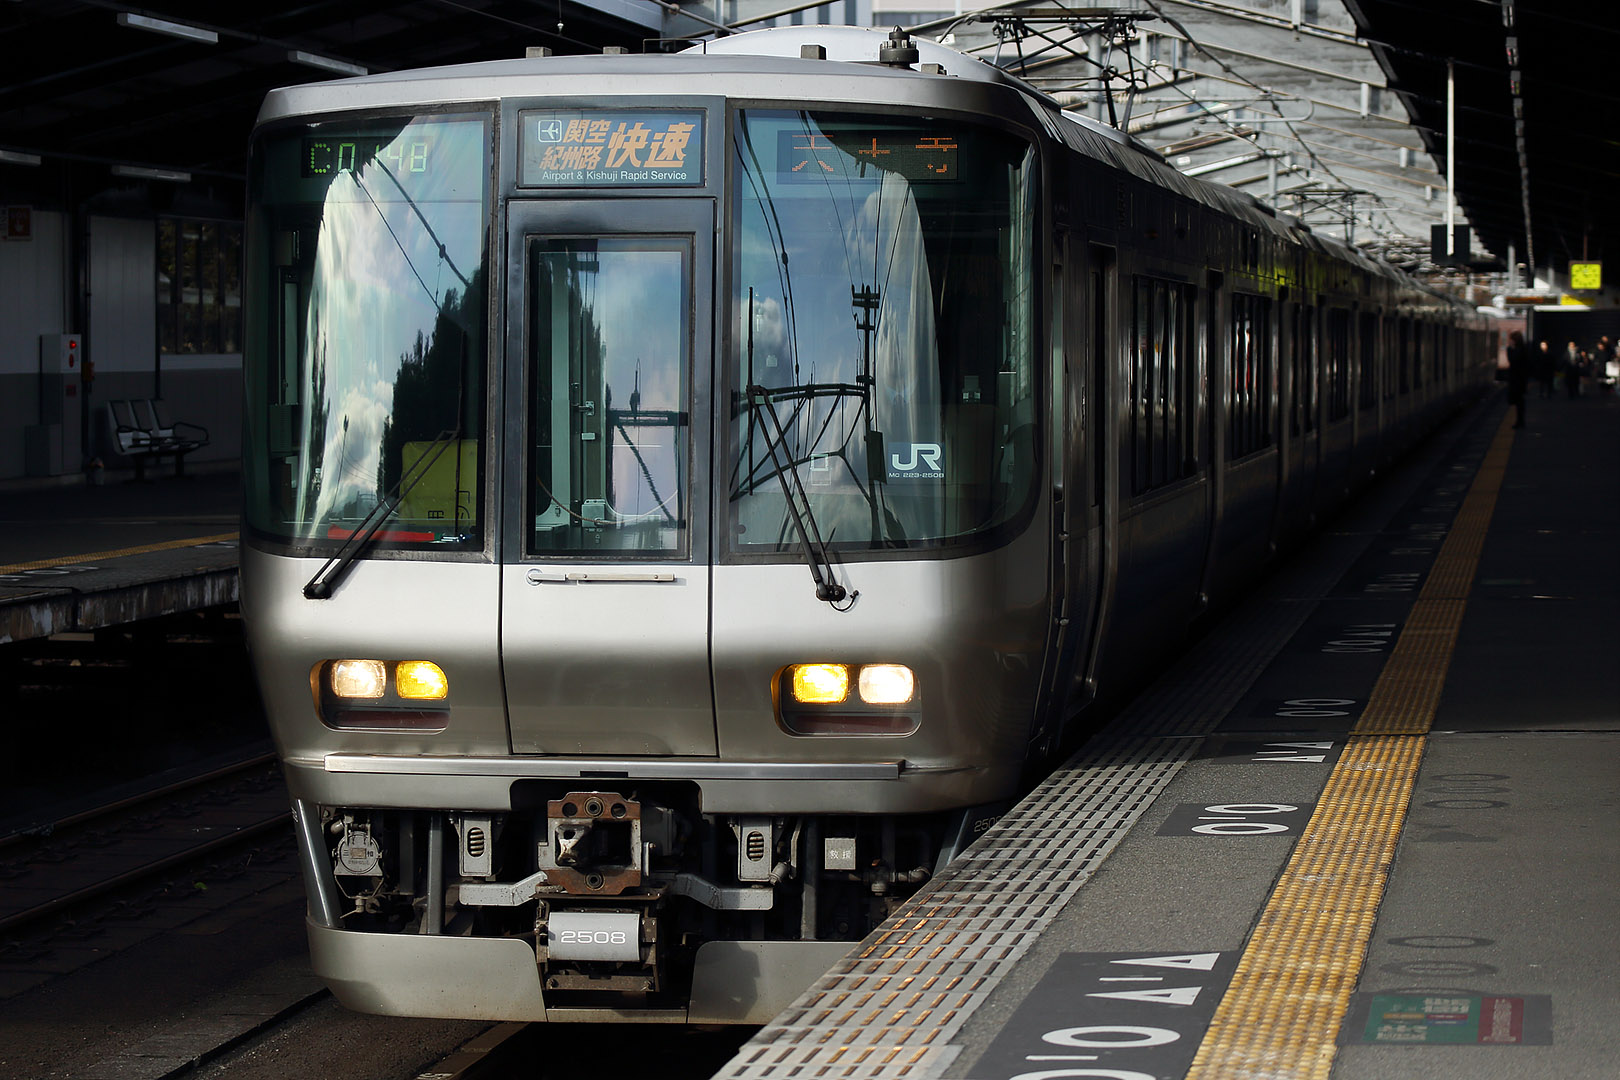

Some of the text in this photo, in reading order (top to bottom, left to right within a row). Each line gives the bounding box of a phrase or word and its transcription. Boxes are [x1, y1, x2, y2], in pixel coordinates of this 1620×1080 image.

[563, 119, 612, 143] 関空
[605, 122, 695, 168] 快速
[539, 145, 604, 170] 紀州路
[542, 170, 687, 182] Airport & Kishuji Rapid Service
[892, 443, 942, 471] JR
[560, 930, 626, 944] 2508
